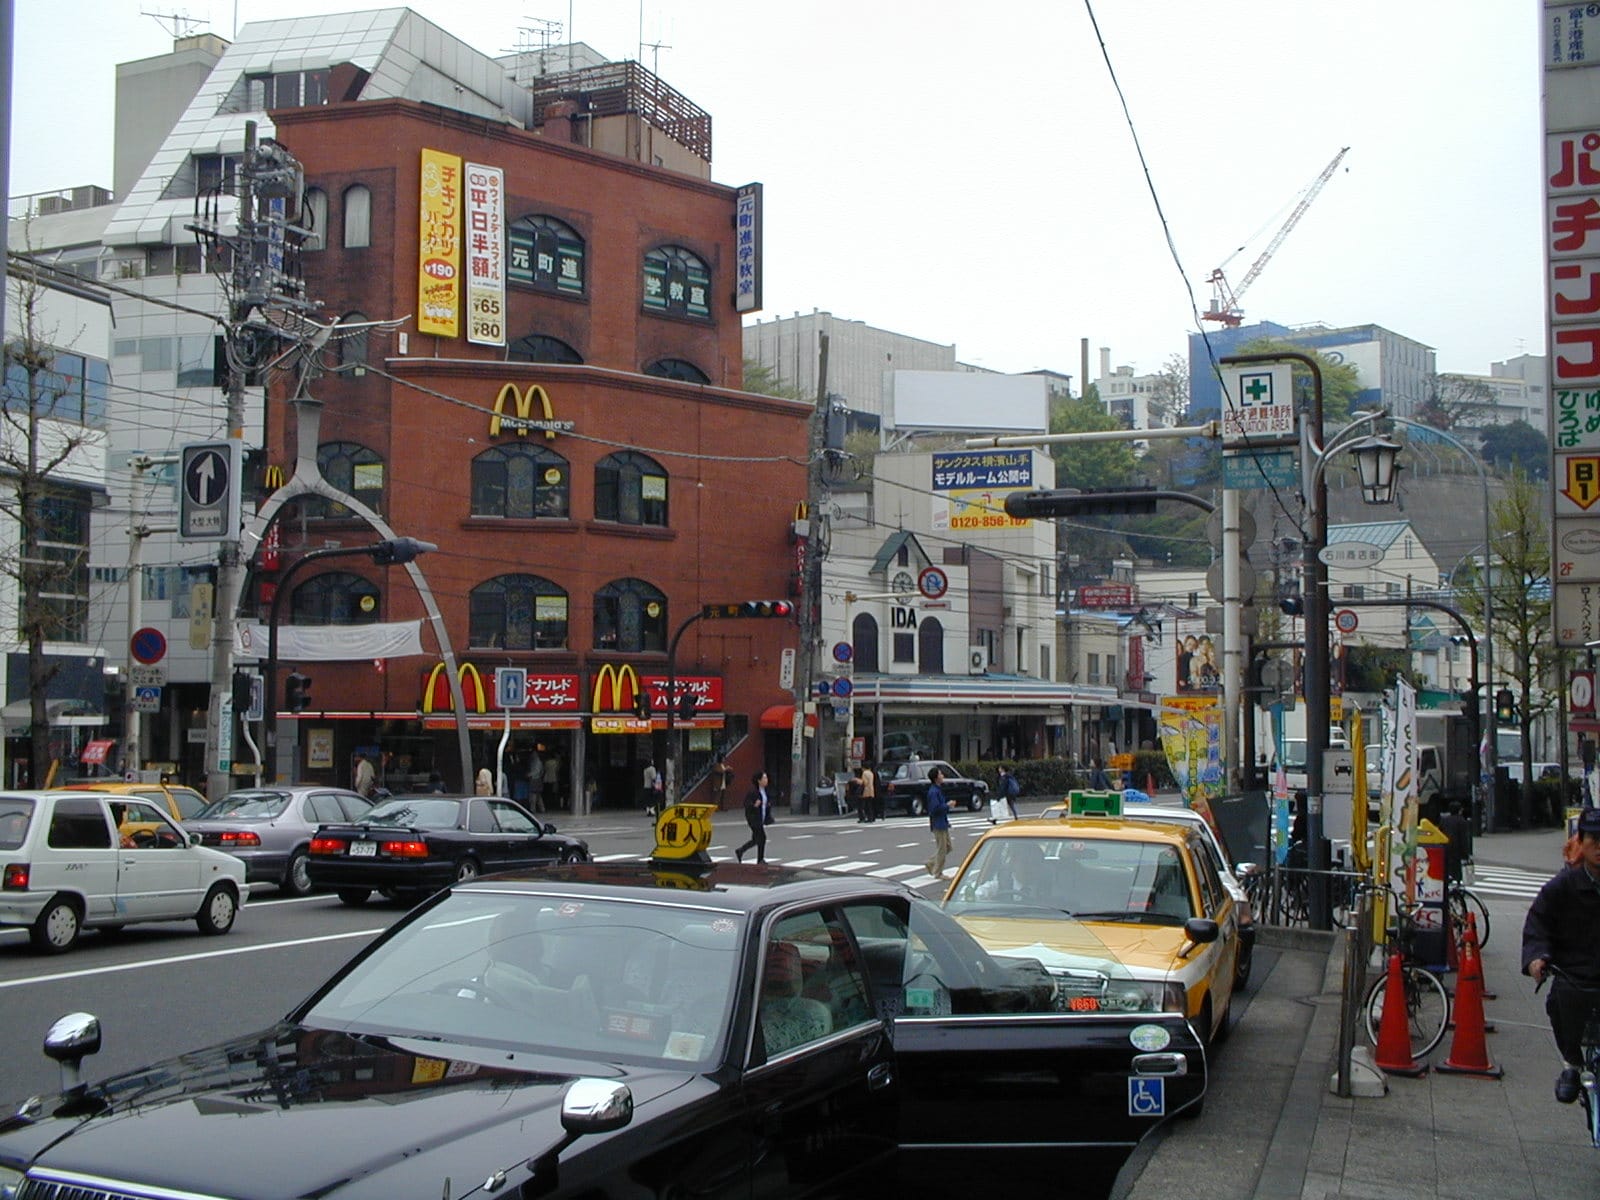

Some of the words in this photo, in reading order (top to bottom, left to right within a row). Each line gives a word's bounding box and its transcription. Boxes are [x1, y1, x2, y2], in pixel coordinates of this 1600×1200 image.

[441, 166, 456, 257] チキンカツ
[470, 188, 489, 278] 平日半額
[739, 197, 753, 294] 元町進学教室
[1550, 133, 1600, 378] パチンコ
[424, 263, 454, 278] ¥190
[473, 299, 500, 315] ¥65
[473, 322, 500, 338] ¥80
[934, 469, 1030, 486] モデルルーム公開中
[1560, 562, 1574, 577] 2F
[891, 606, 917, 629] IDA
